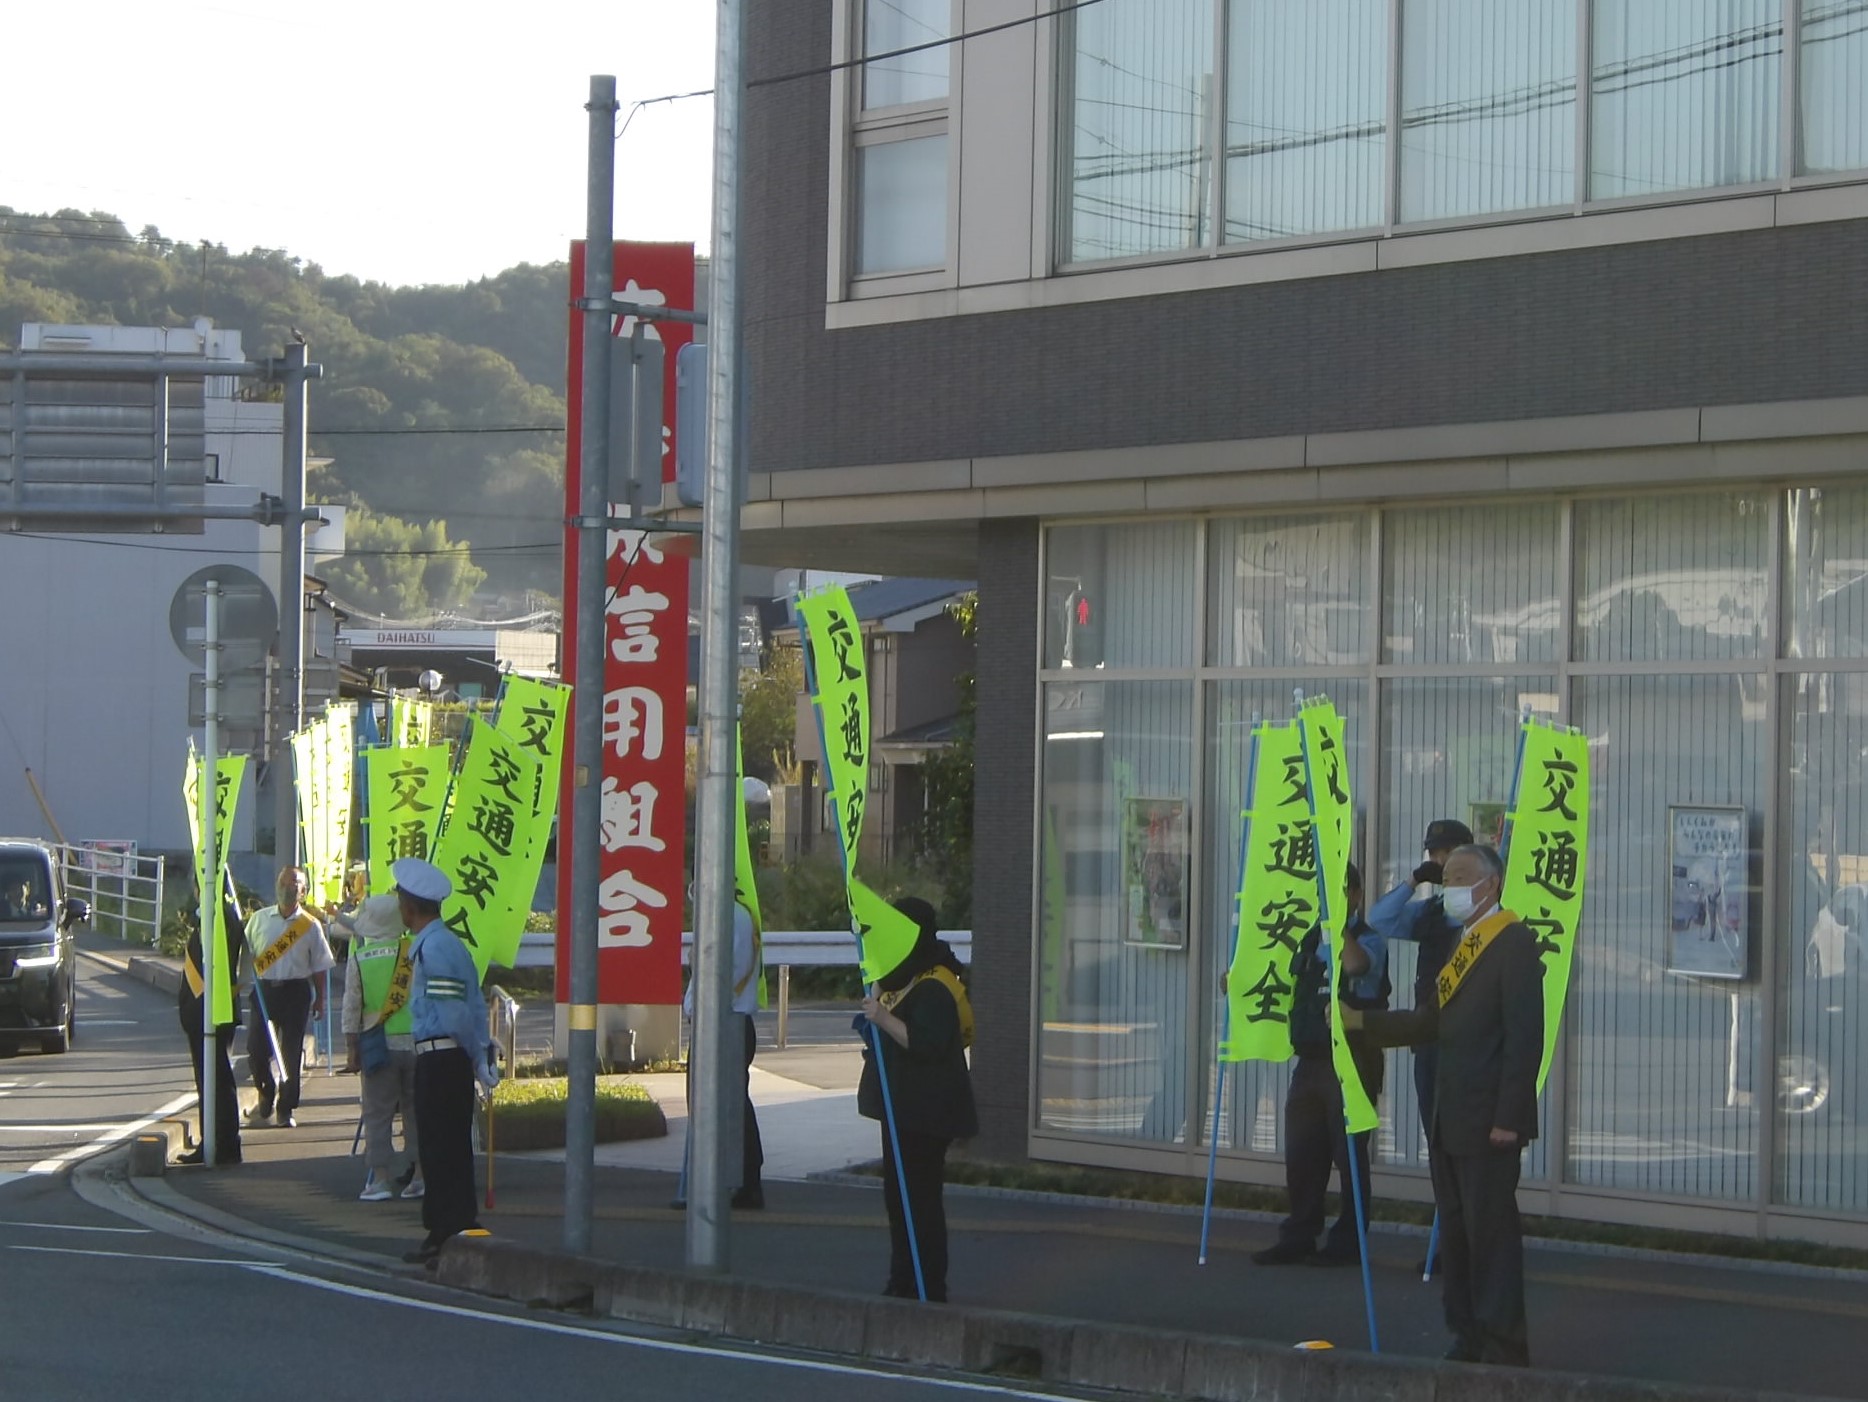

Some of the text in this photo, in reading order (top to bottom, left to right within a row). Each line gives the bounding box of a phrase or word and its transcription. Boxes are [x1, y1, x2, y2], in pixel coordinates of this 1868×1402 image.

[377, 632, 435, 643] DAIHATSU
[1242, 743, 1317, 1023] 交通安全
